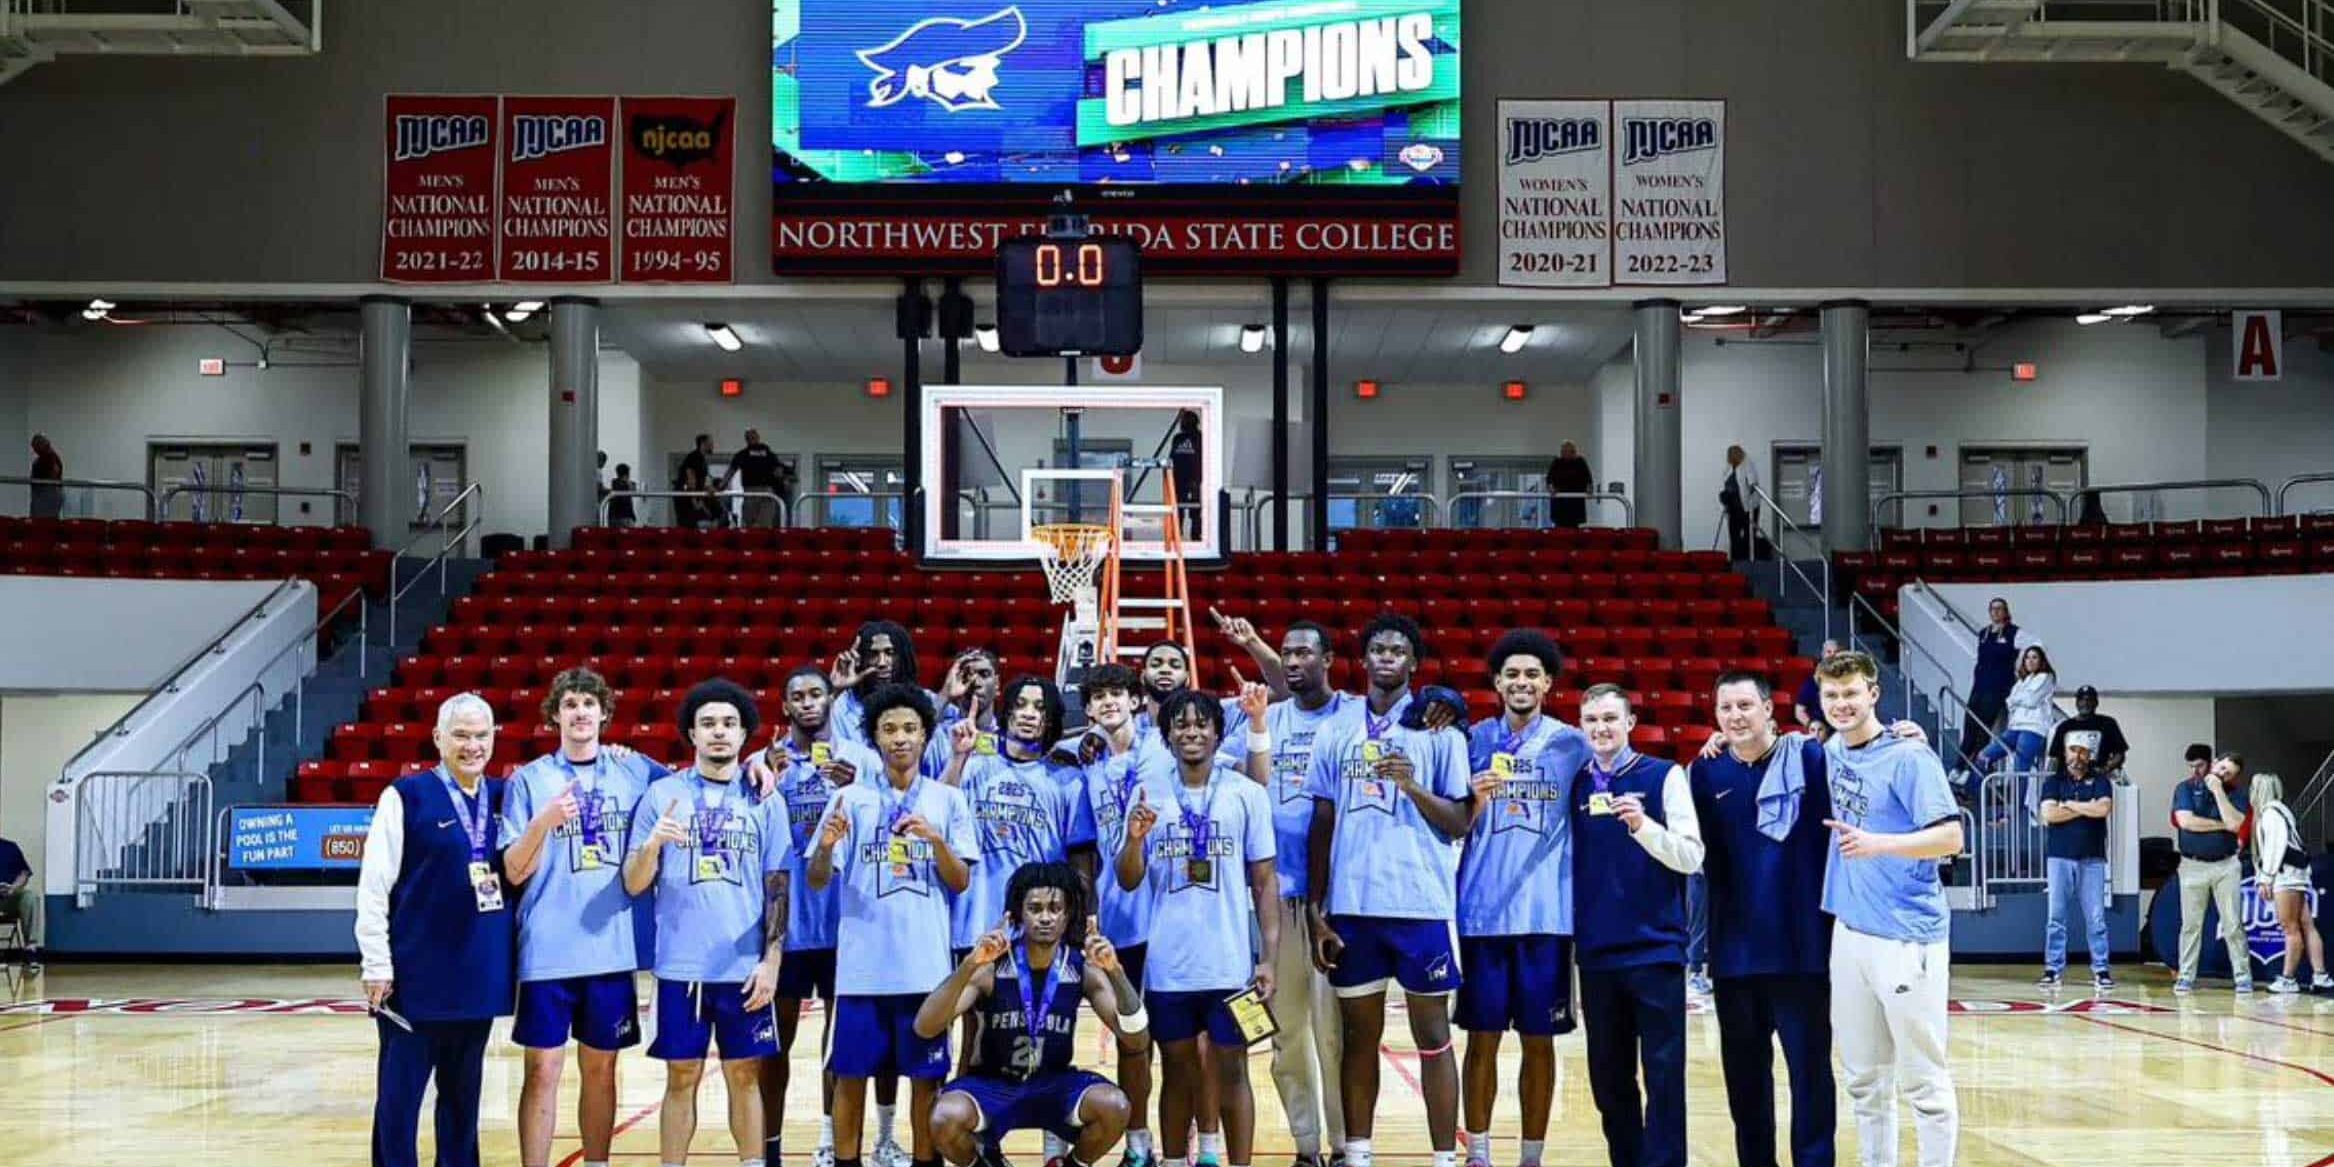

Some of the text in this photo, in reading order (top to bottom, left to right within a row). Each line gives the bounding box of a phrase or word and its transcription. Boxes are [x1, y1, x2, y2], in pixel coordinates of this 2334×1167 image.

[1105, 13, 1433, 127] CHAMPIONS
[396, 115, 489, 160] NJCAA
[512, 115, 605, 161] NJCAA
[643, 125, 711, 154] njcaa
[1506, 118, 1601, 166] NJCAA
[1623, 118, 1717, 166] NJCAA
[418, 174, 464, 188] MEN'S
[534, 176, 580, 191] MEN'S
[655, 175, 700, 189] MEN'S
[1519, 178, 1588, 191] WOMEN'S
[1635, 174, 1704, 189] WOMEN'S
[392, 194, 488, 214] NATIONAL
[507, 197, 605, 216] NATIONAL
[628, 194, 726, 214] NATIONAL
[1505, 197, 1603, 216] NATIONAL
[1621, 199, 1718, 218] NATIONAL
[388, 217, 490, 237] CHAMPIONS
[504, 217, 609, 237] CHAMPIONS
[626, 217, 727, 237] CHAMPIONS
[778, 222, 1002, 251] NORTHWEST
[1184, 222, 1285, 251] STATE
[1295, 222, 1455, 251] COLLEGE
[1502, 220, 1606, 240] CHAMPIONS
[1616, 222, 1720, 240] CHAMPIONS
[396, 251, 484, 270] 2021-22
[512, 251, 599, 271] 2014-15
[632, 251, 721, 271] 1994-95
[1035, 244, 1102, 286] 0.0
[1511, 253, 1597, 272] 2020-21
[1628, 255, 1713, 273] 2022-23
[2238, 316, 2277, 376] A
[240, 812, 294, 831] OWNING A
[236, 828, 298, 848] POOL IS THE
[327, 838, 360, 857] (850)
[243, 845, 293, 864] FUN PART
